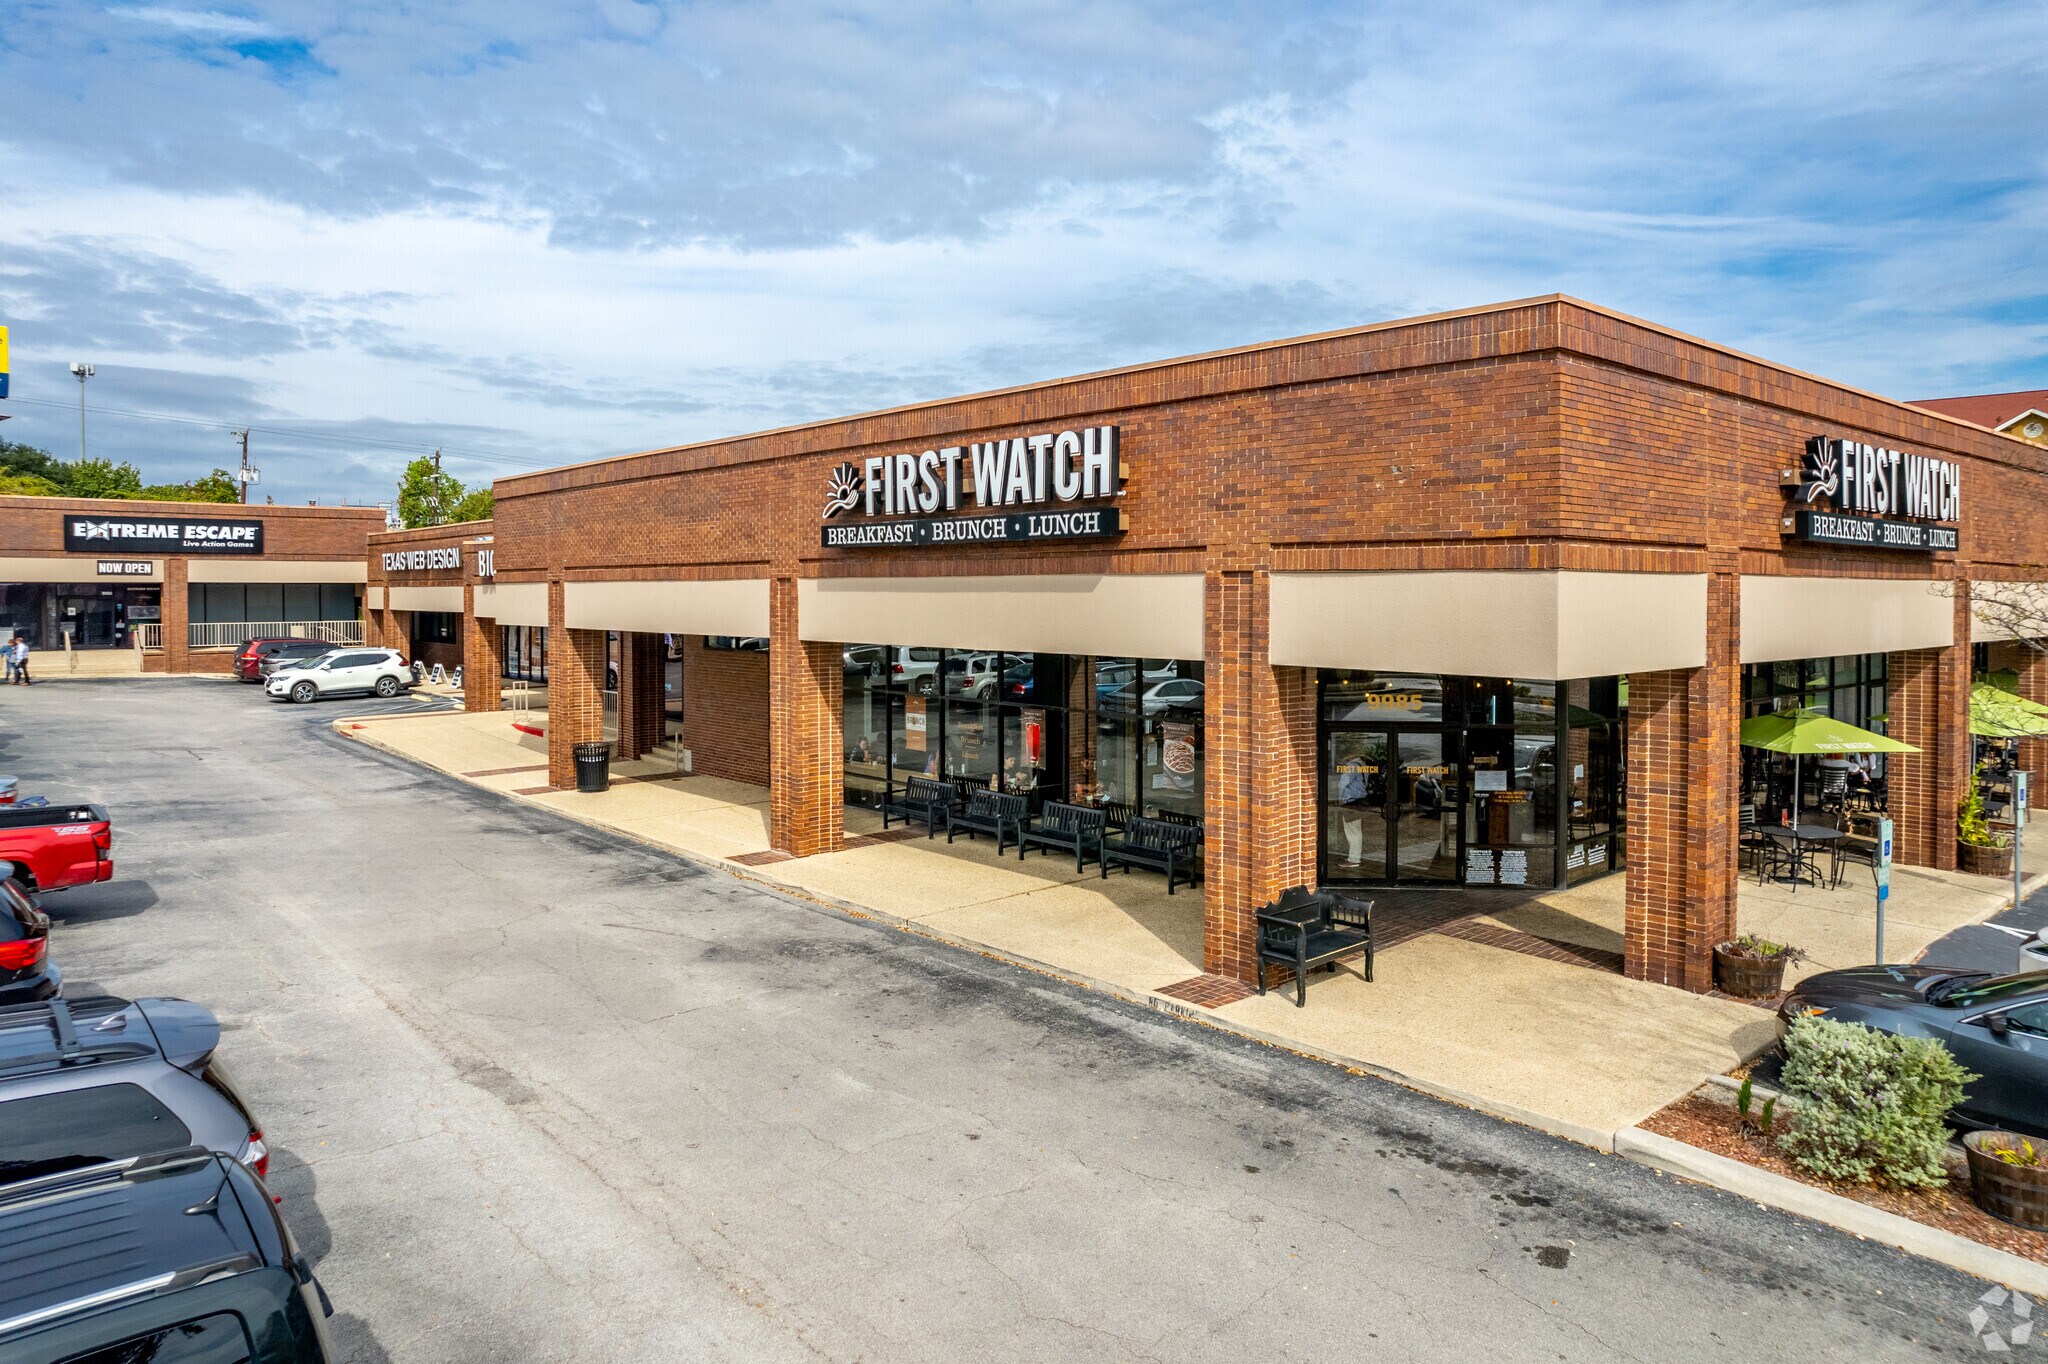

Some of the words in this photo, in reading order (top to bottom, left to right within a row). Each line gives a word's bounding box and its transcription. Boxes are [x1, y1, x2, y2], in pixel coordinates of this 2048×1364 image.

[865, 446, 964, 516] FIRST
[971, 425, 1115, 508] WATCH
[1842, 439, 1900, 515] FIRST
[1903, 453, 1960, 522] WATCH
[73, 520, 179, 541] EXTREME
[184, 525, 256, 540] ESCAPE
[827, 523, 914, 545] BREAKFAST
[931, 518, 1007, 541] BRUNCH
[1028, 511, 1100, 536] LUNCH
[1813, 515, 1875, 542] BREAKFAST
[1883, 524, 1921, 546] BRUNCH
[1929, 529, 1956, 548] LUNCH
[99, 562, 124, 573] NOW
[125, 563, 151, 574] OPEN
[382, 552, 406, 571] TEXAS
[406, 550, 425, 570] WEB
[427, 548, 460, 569] DESIGN
[1367, 693, 1423, 711] 9985
[960, 735, 981, 745] Brunch
[1336, 765, 1355, 773] FIRST
[1357, 765, 1379, 774] WATCH
[1406, 766, 1425, 774] FIRST
[1426, 766, 1449, 775] WATCH
